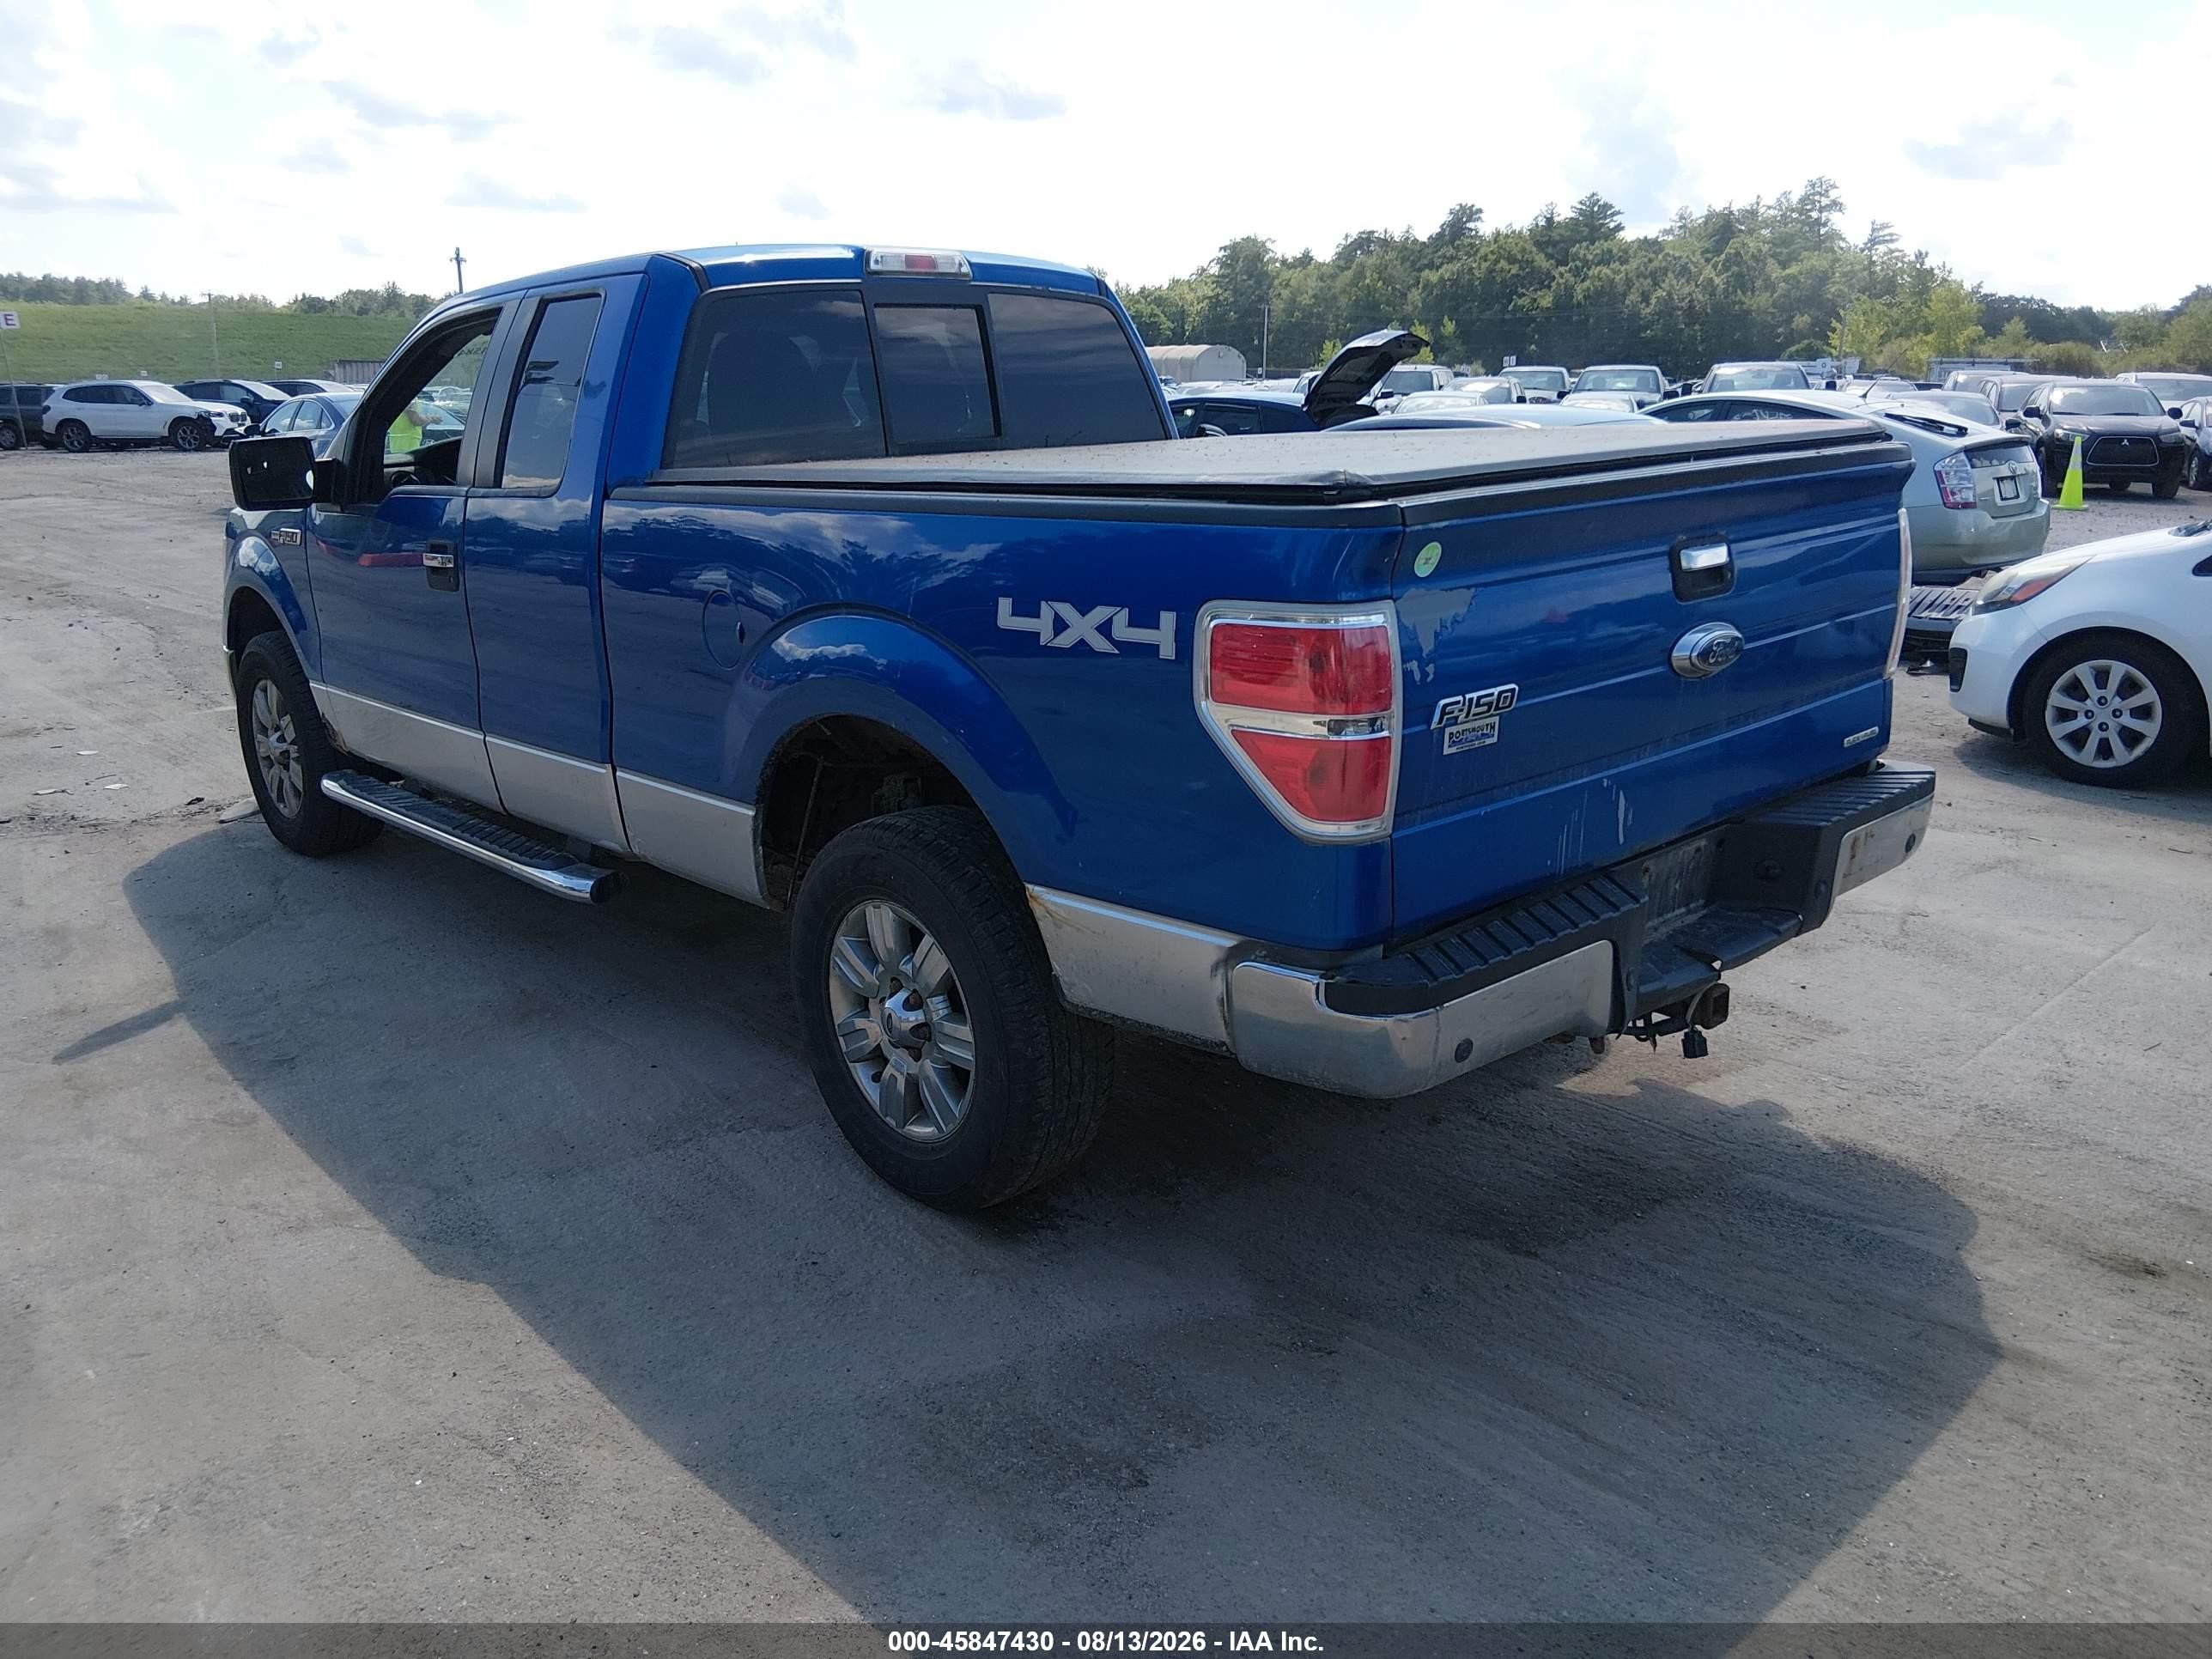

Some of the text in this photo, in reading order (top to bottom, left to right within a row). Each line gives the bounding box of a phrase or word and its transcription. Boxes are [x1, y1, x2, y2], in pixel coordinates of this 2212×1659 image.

[3, 313, 16, 326] E
[1708, 638, 1741, 664] Ford
[1431, 684, 1518, 730] F-150
[1448, 721, 1496, 744] PORTSMOUTH
